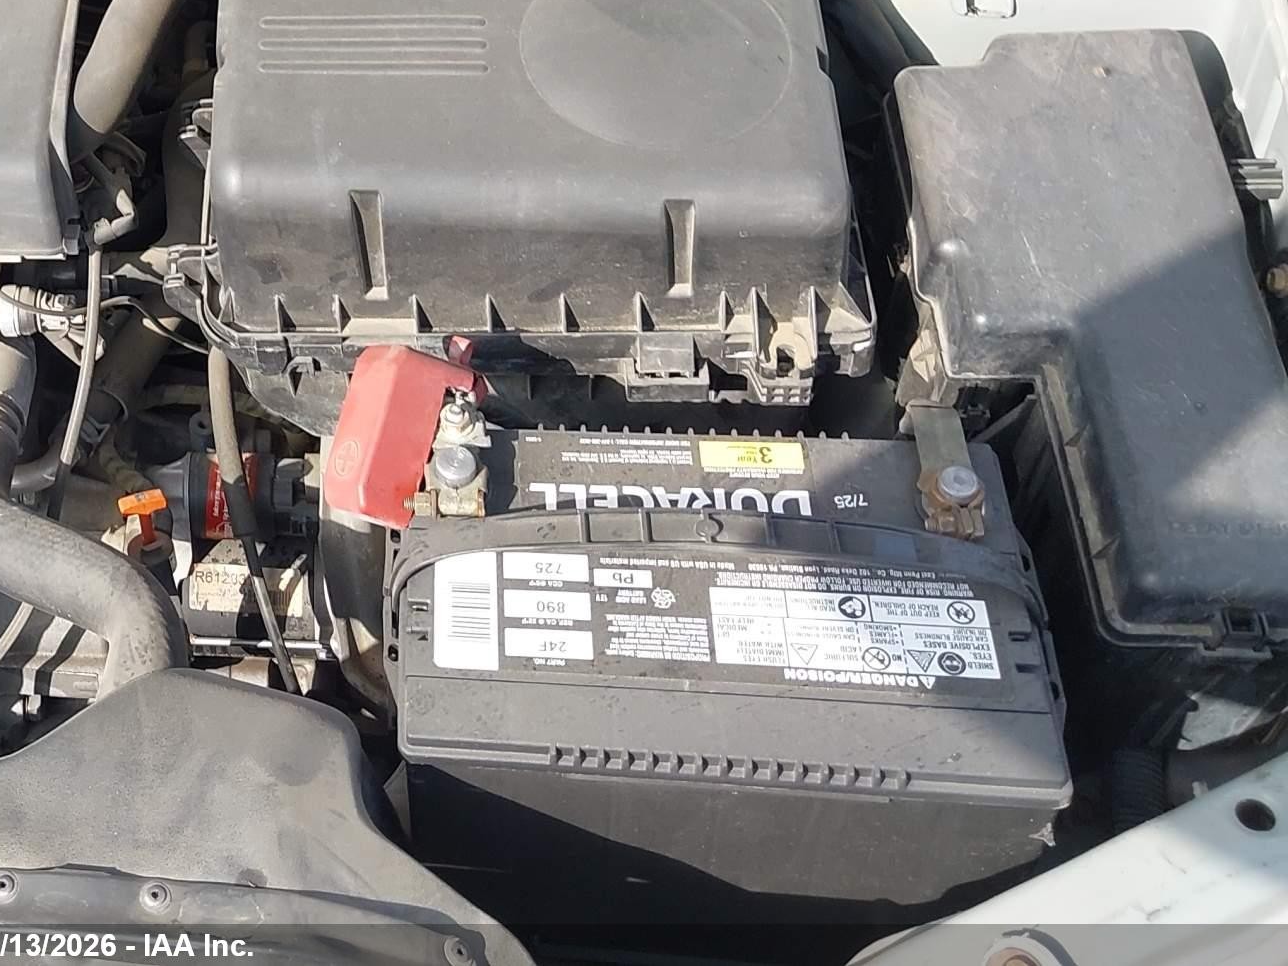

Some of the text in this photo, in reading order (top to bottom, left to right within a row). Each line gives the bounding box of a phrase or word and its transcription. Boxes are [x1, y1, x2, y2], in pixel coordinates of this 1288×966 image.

[758, 446, 772, 464] 3
[528, 482, 812, 516] DURACELL
[834, 494, 868, 508] 7/25
[600, 558, 628, 566] materials
[630, 558, 656, 566] imported
[680, 560, 694, 569] with
[695, 561, 708, 570] USA
[716, 562, 735, 570] Made
[535, 562, 564, 574] 725
[804, 565, 820, 573] Lyon
[612, 572, 634, 584] Pb
[794, 575, 818, 583] PROPER
[820, 576, 844, 584] FOLLOW
[805, 582, 816, 590] NOT
[907, 580, 954, 589] RECOMMENDED
[863, 586, 898, 594] EXPLOSION
[925, 588, 940, 596] RISK
[536, 600, 566, 614] 890
[887, 608, 898, 616] THE
[924, 610, 940, 618] KEEP
[914, 632, 950, 640] BLINDNESS
[952, 634, 974, 642] CAUSE
[538, 641, 566, 652] 24F
[922, 640, 990, 651] EXPLOSIVE GASES
[892, 654, 902, 662] NO
[967, 662, 994, 670] SHIELD
[783, 668, 919, 688] DANGER/POISON
